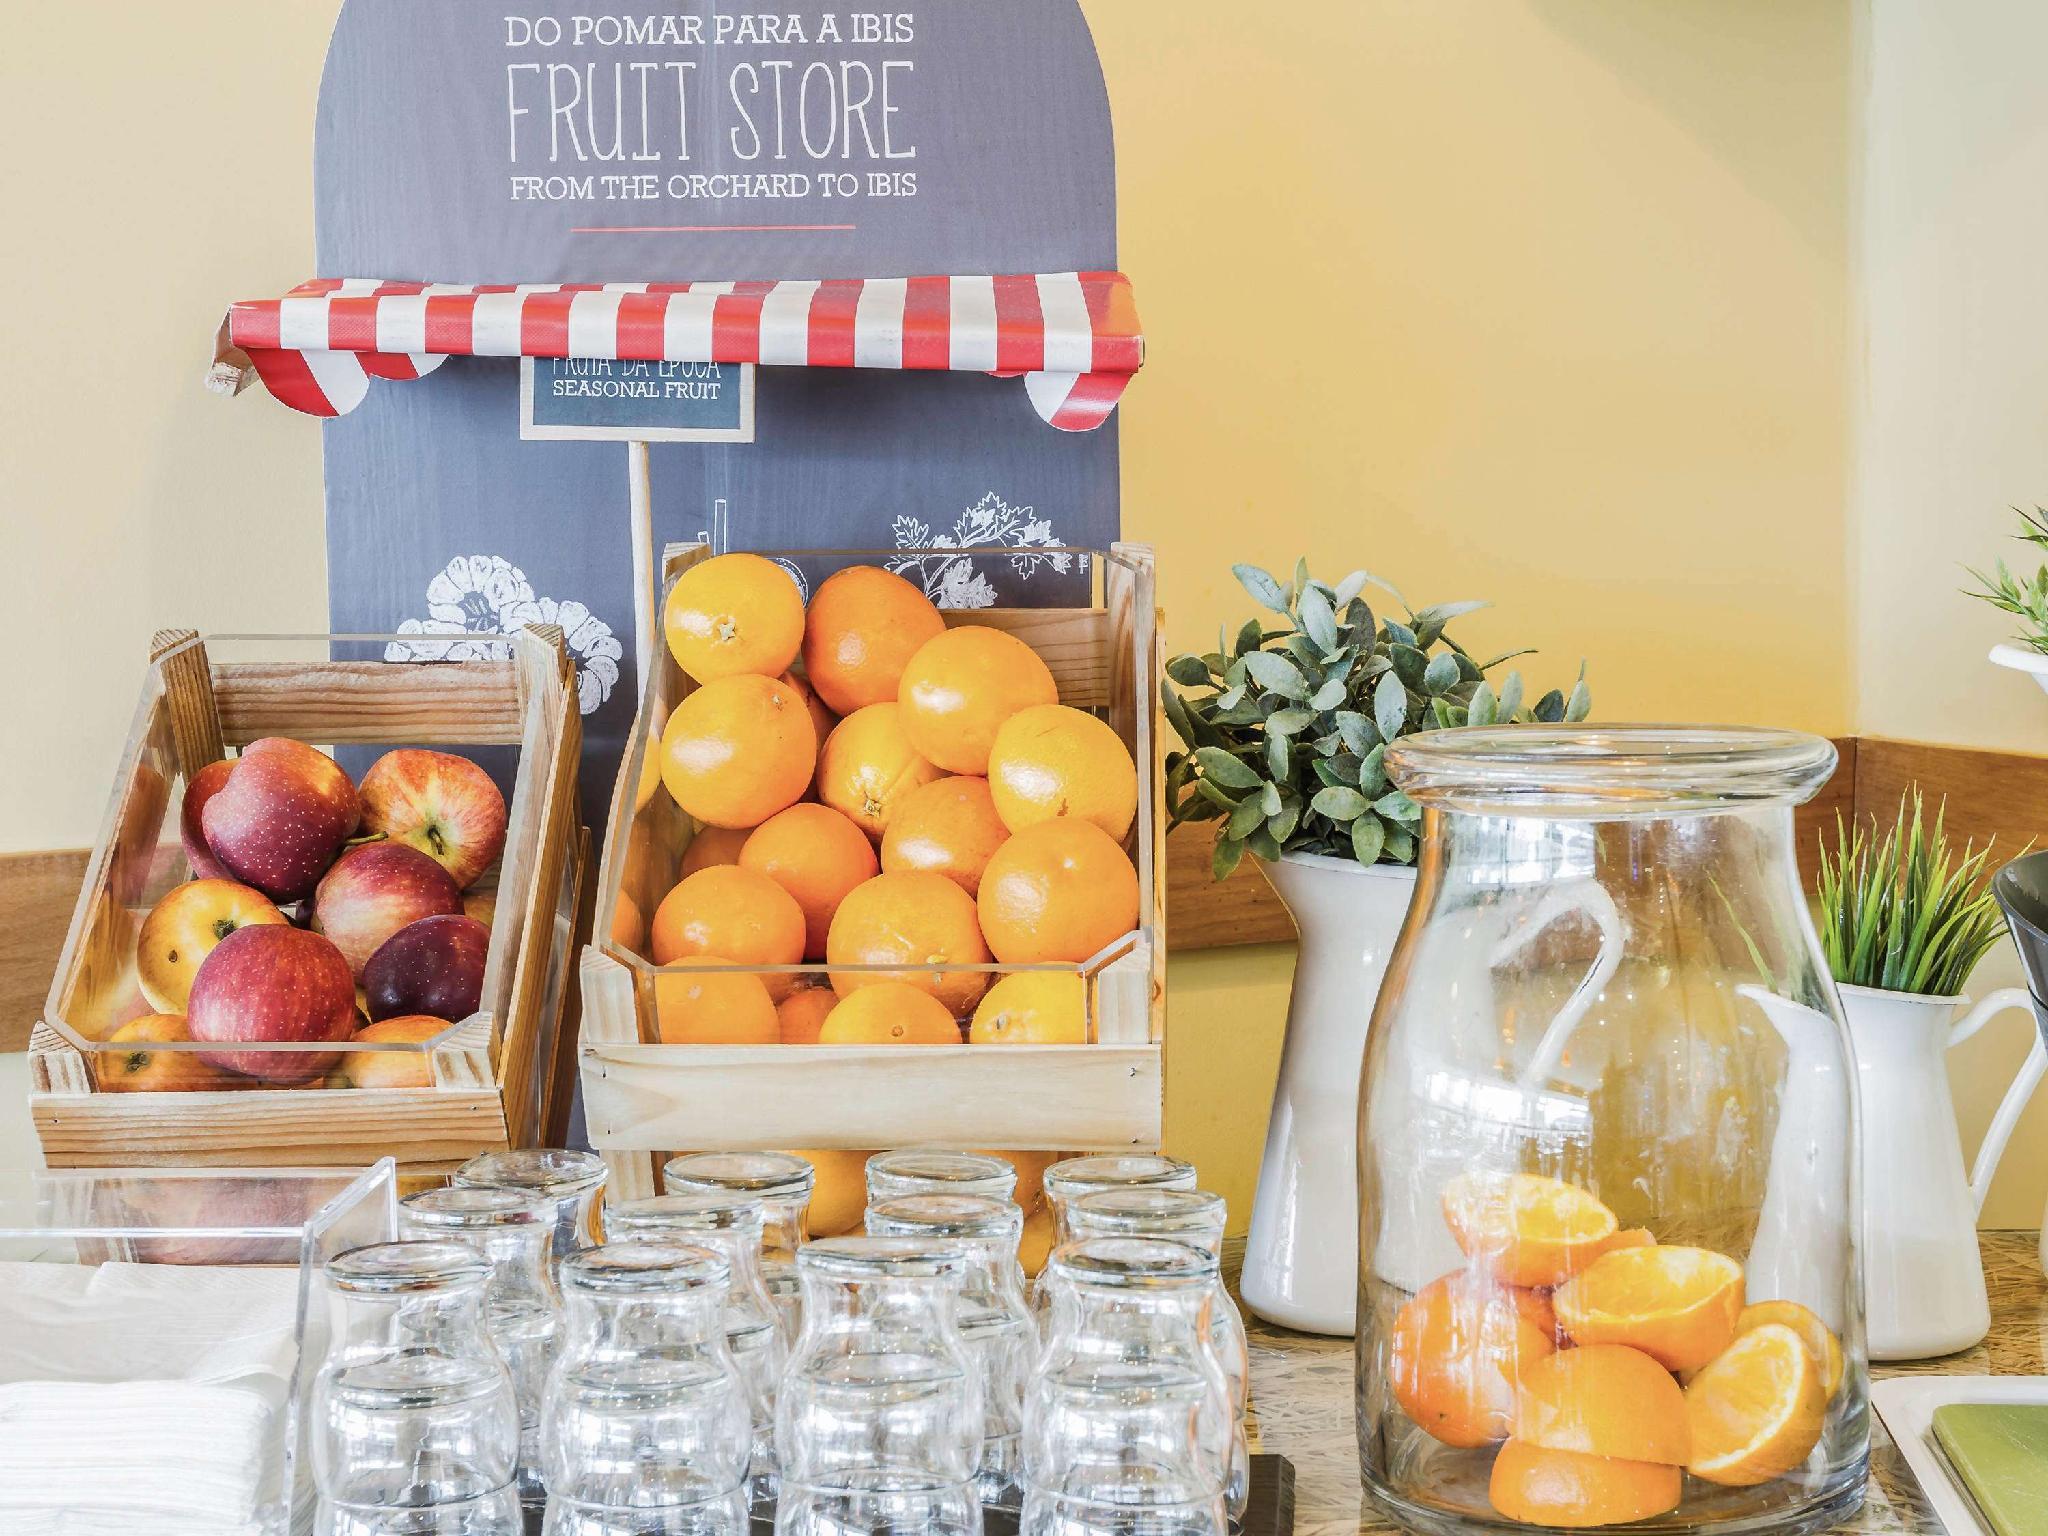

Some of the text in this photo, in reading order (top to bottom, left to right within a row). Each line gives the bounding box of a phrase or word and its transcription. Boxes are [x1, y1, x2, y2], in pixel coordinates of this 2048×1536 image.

[504, 13, 914, 46] DO POMAR PARA A IBIS
[507, 60, 916, 162] FRUIT STORE
[510, 172, 917, 200] FROM THE ORCHARD TO IBIS
[553, 380, 720, 400] SEASONAL FRUIT
